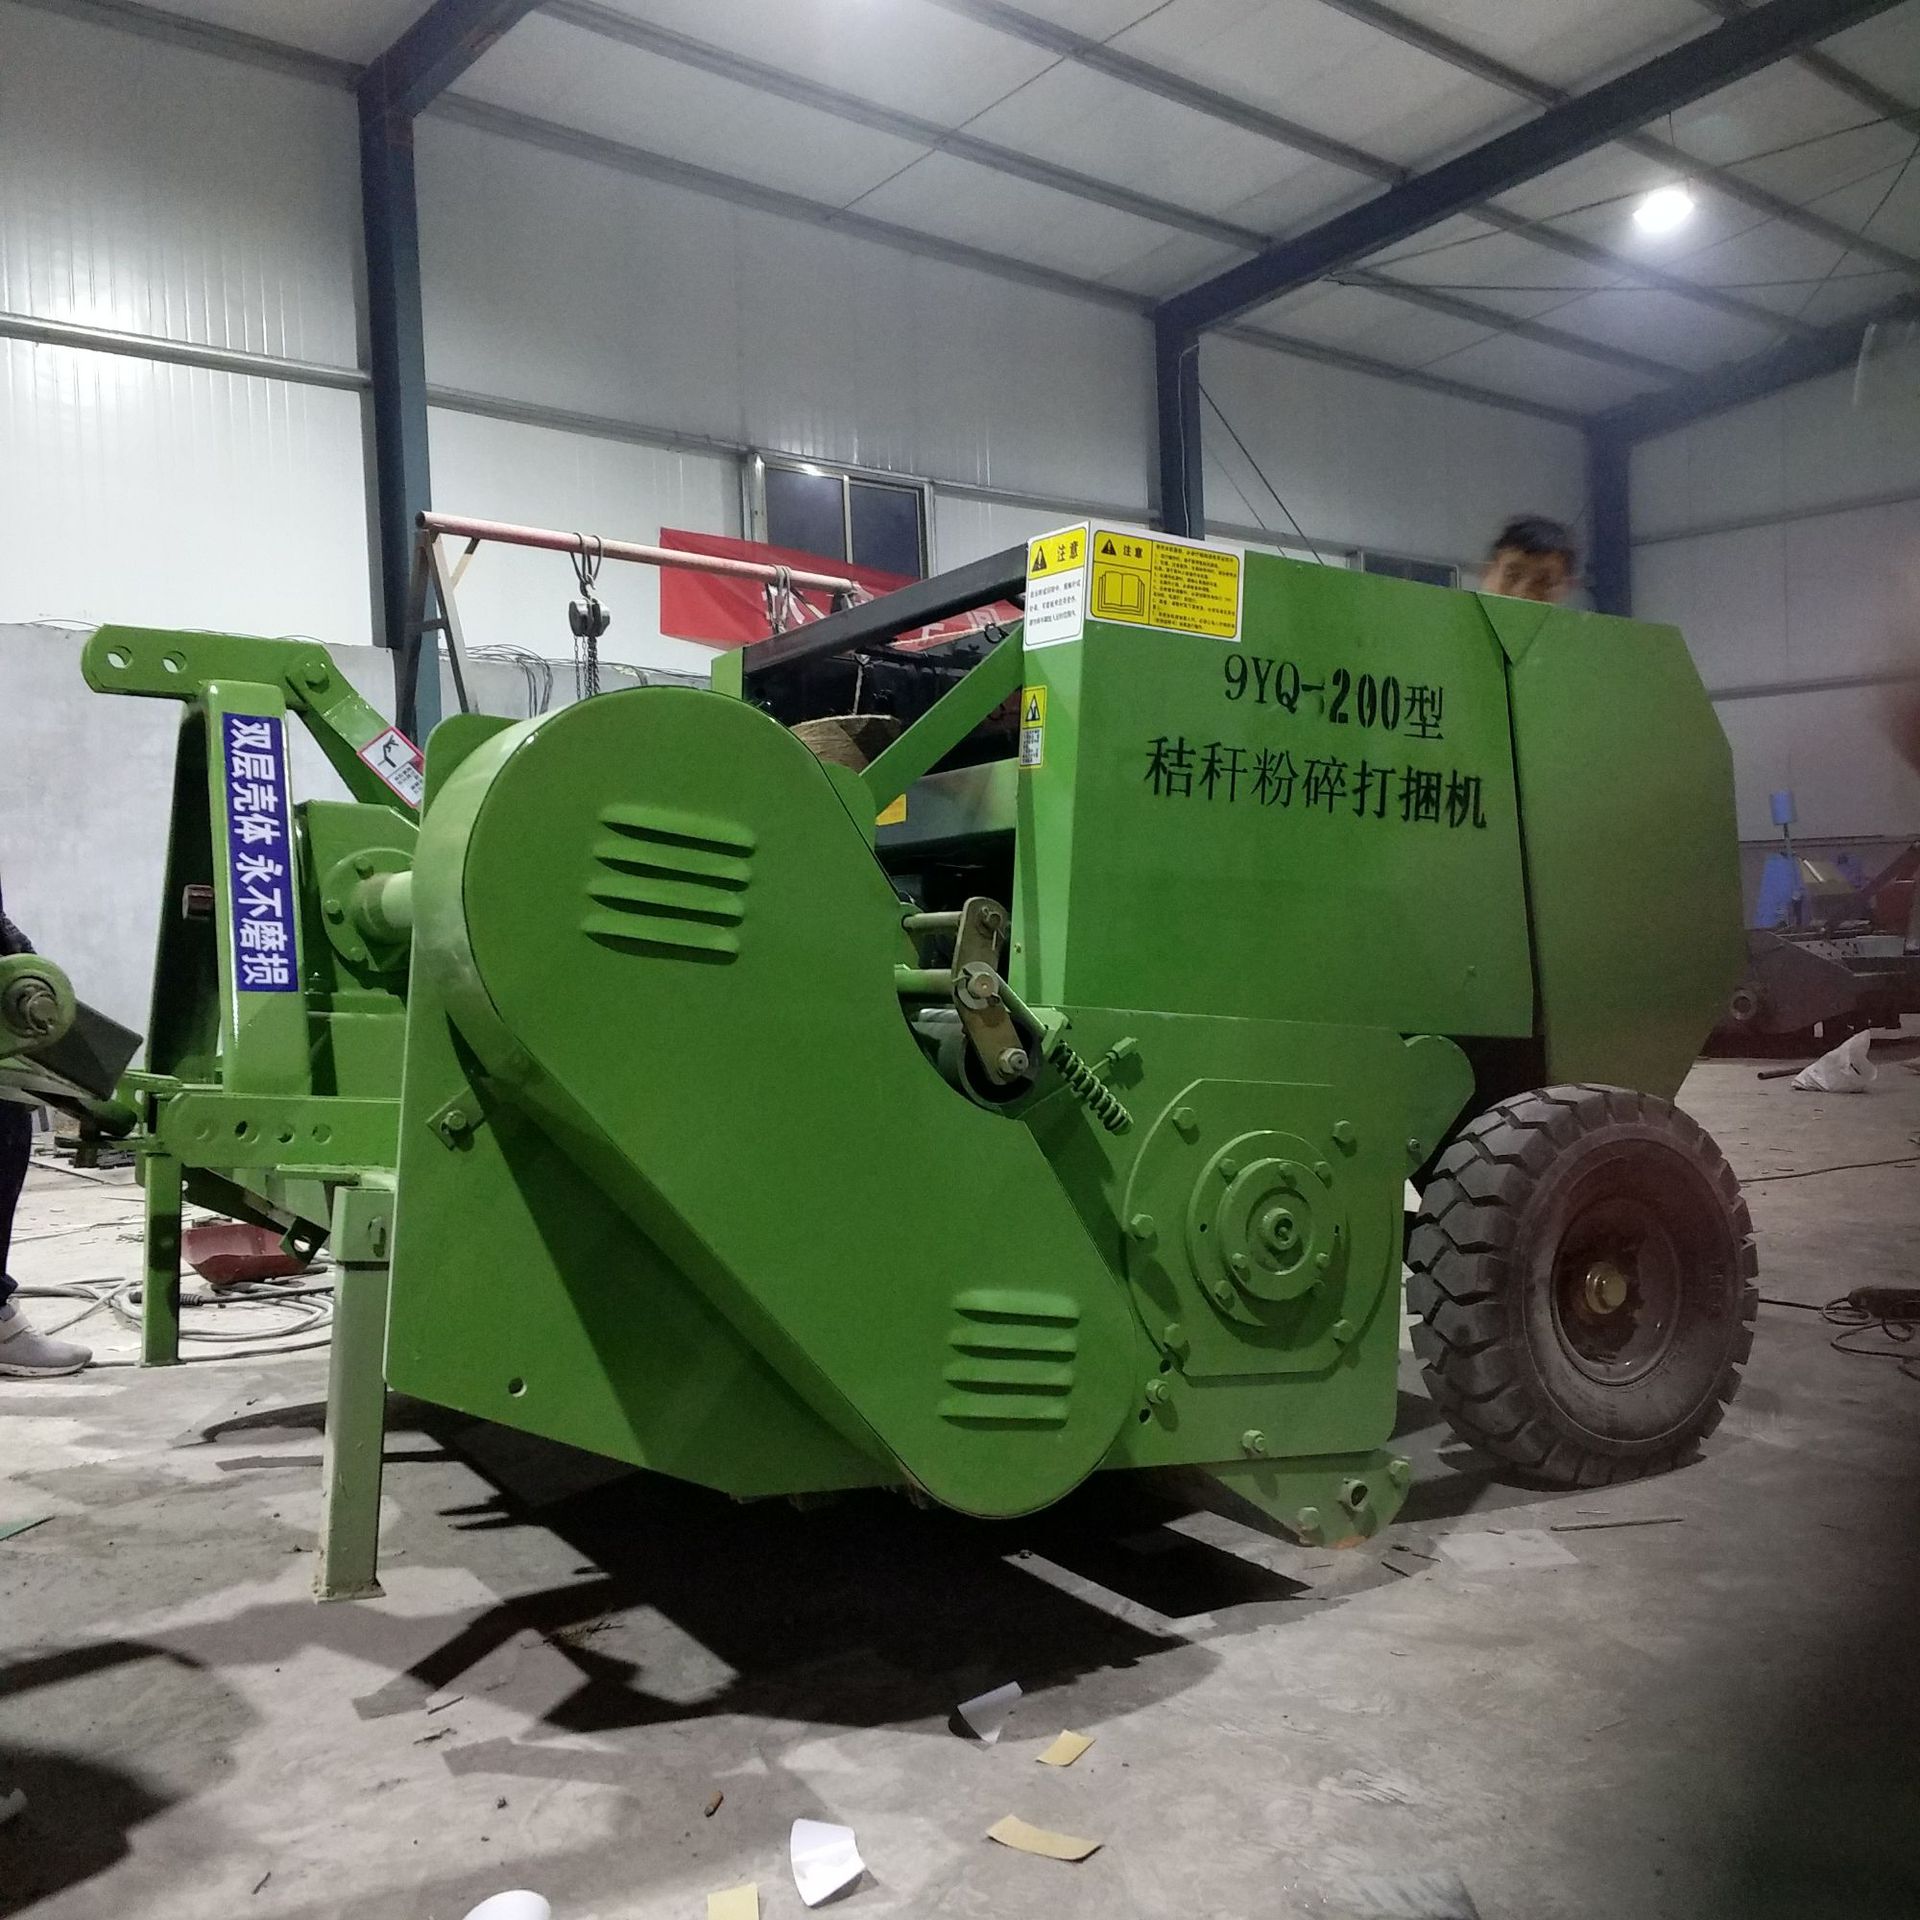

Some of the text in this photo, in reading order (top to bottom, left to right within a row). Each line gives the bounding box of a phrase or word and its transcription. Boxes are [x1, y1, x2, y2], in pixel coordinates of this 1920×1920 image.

[1057, 540, 1079, 562] 注意
[1123, 545, 1143, 559] 注意
[1224, 653, 1444, 740] 9YQ-200型
[1144, 735, 1487, 829] 秸秆粉碎打捆机
[230, 718, 289, 985] 双层壳体 永不磨损
